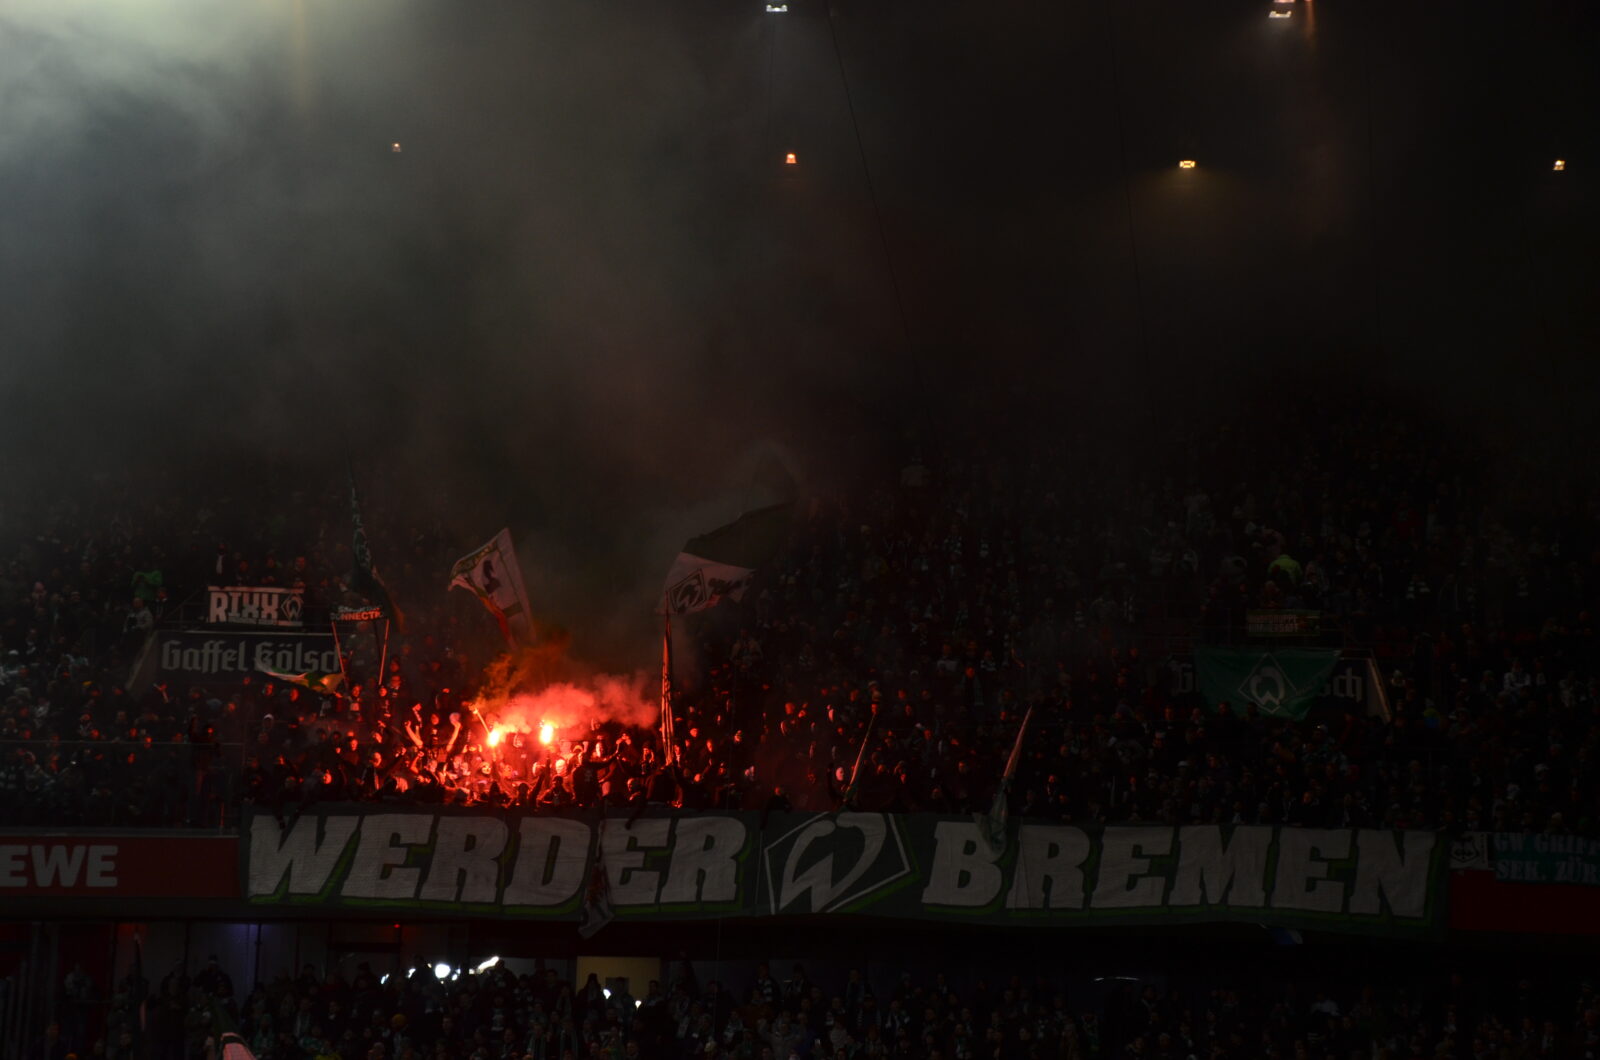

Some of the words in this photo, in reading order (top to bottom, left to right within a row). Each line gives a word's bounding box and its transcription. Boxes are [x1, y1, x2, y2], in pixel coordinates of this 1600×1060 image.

[161, 639, 250, 673] Gaffel
[248, 813, 747, 906] WERDER
[920, 820, 1437, 918] BREMEN
